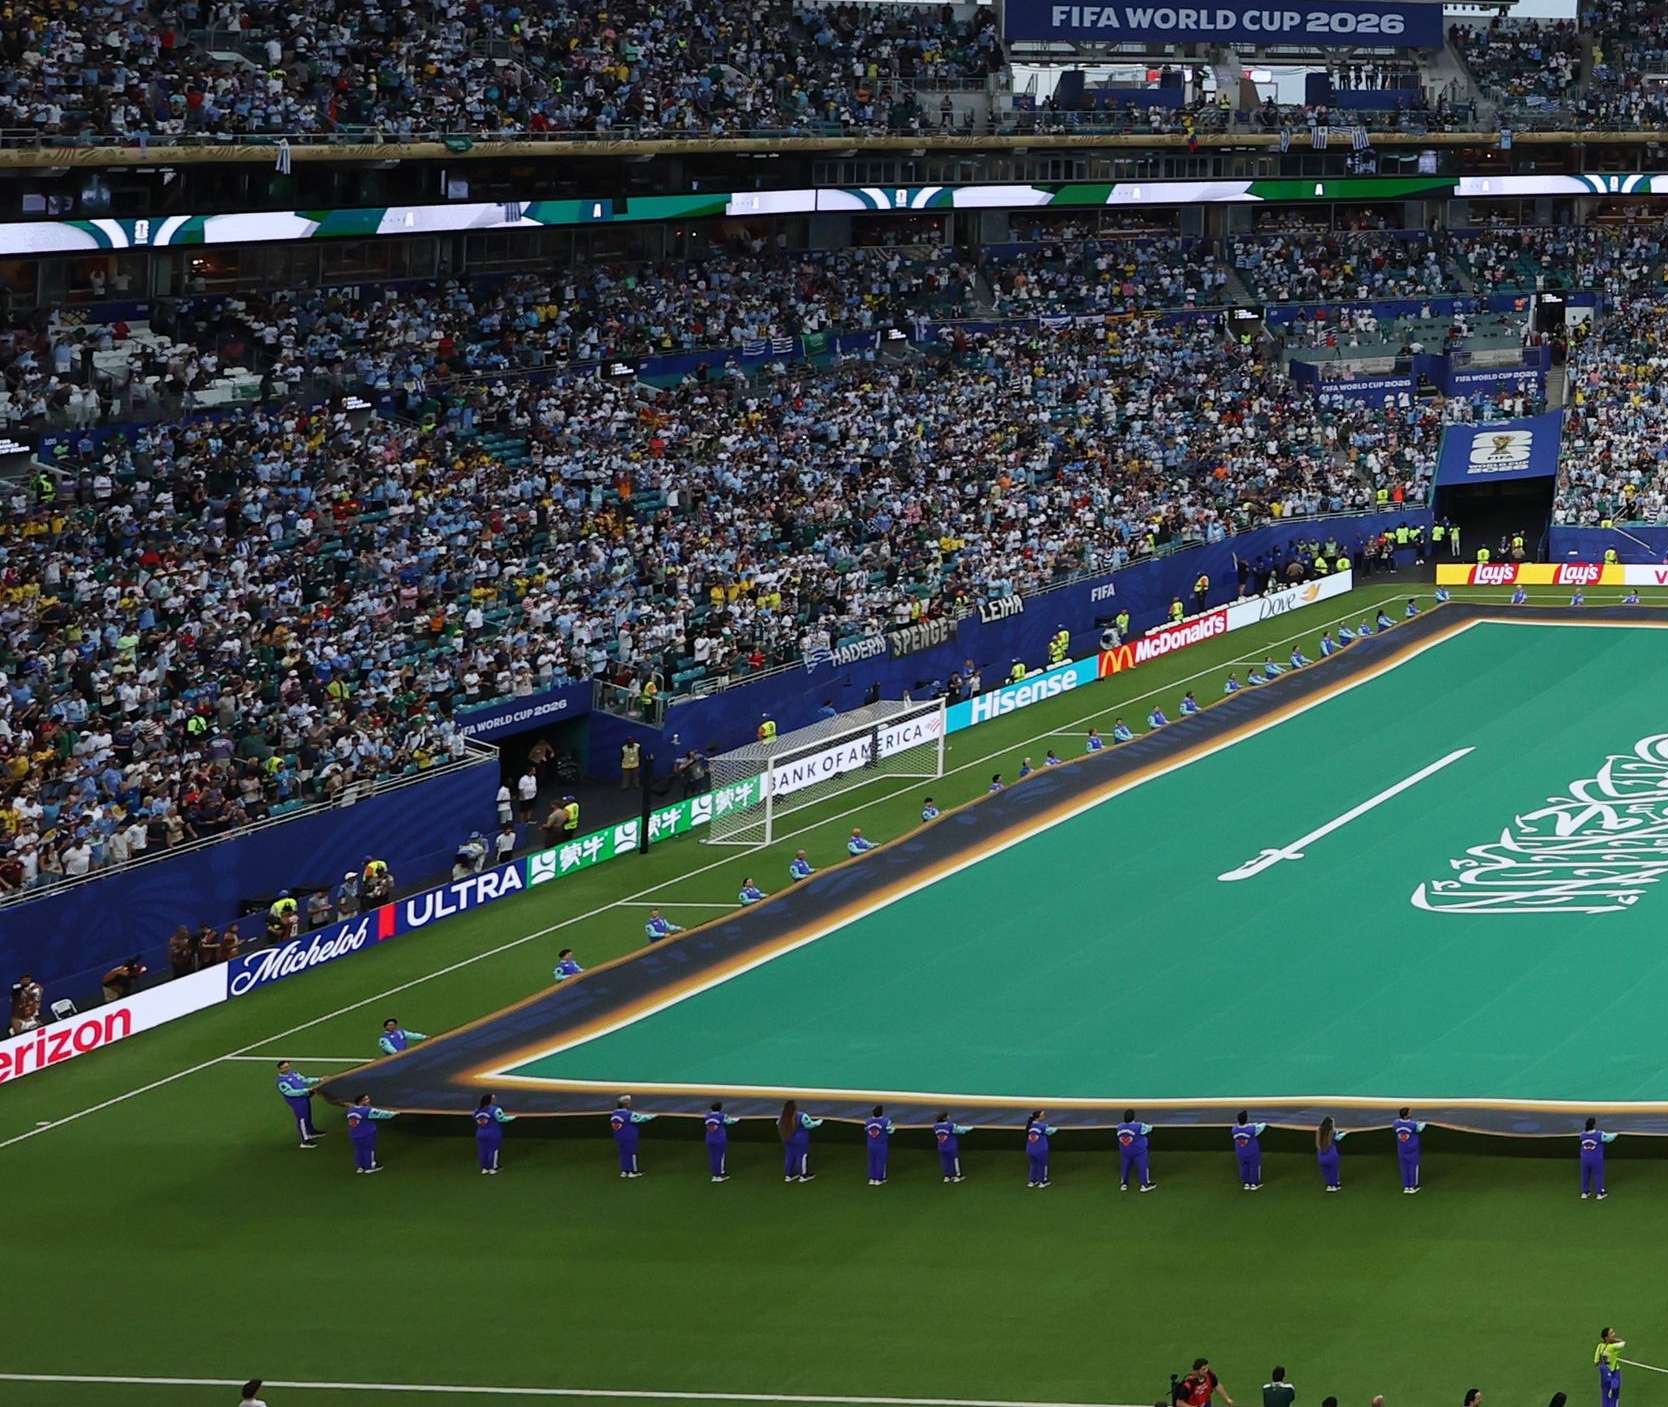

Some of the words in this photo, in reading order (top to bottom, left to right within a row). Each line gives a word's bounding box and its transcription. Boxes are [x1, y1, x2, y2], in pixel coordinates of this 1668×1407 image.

[1052, 5, 1118, 29] FIFA
[1125, 6, 1237, 32] WORLD
[1242, 8, 1302, 33] CUP
[1306, 11, 1405, 35] 2026
[1341, 383, 1367, 391] WORLD
[1368, 381, 1384, 390] CUP
[1385, 379, 1411, 388] 2026
[1500, 373, 1513, 381] CUP
[1513, 371, 1538, 379] 2026
[1473, 564, 1515, 586] Lay's
[1558, 564, 1600, 586] Lay's
[1091, 583, 1115, 602] FIFA
[1259, 590, 1296, 621] Dove
[1136, 612, 1226, 659] McDonald's
[971, 667, 1078, 726] Hisense
[477, 714, 513, 733] WORLD
[514, 708, 534, 722] CUP
[534, 699, 567, 717] 2026
[822, 752, 844, 772] OF
[231, 917, 370, 999] Michelob
[406, 864, 523, 930] ULTRA
